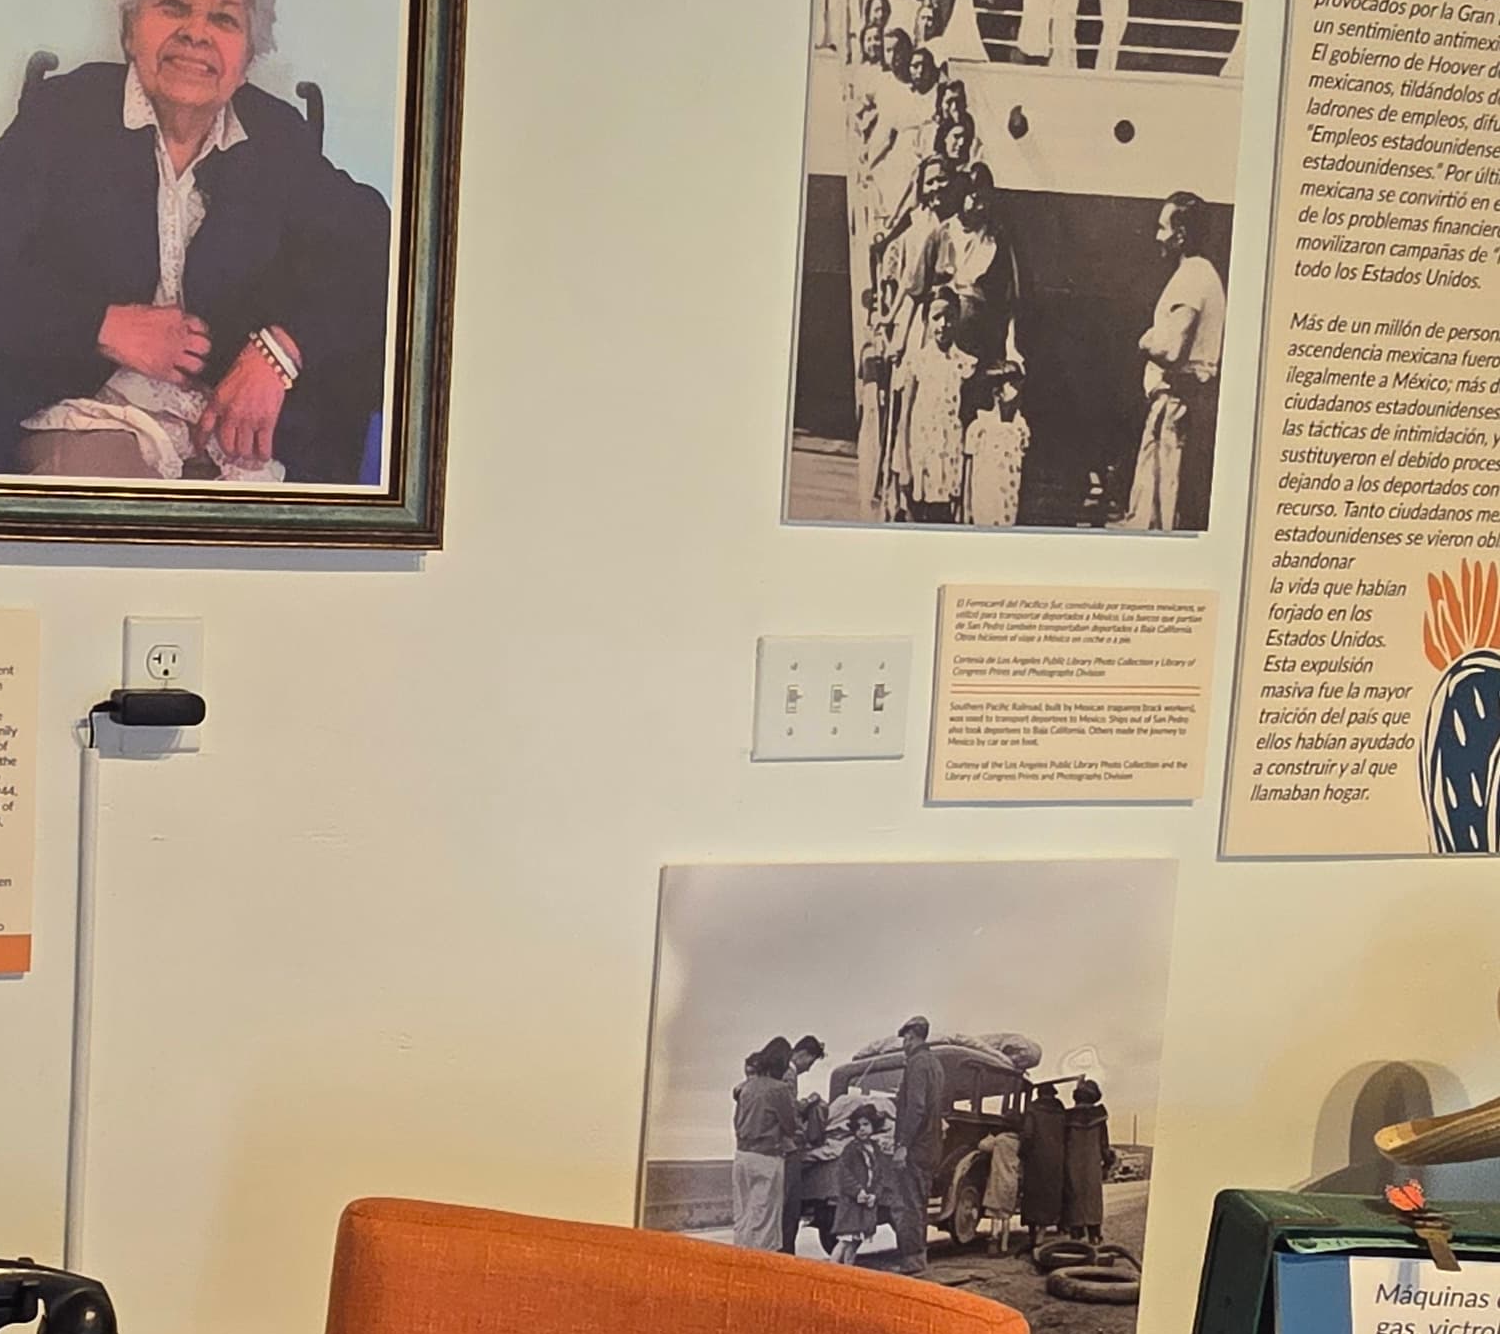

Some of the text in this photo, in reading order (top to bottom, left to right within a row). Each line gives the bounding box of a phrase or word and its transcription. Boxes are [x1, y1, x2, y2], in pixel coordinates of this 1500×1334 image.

[1311, 42, 1485, 77] El gobierno de Hoover
[1294, 259, 1481, 289] todo los Estados Unidos.
[1271, 550, 1357, 570] abandonar
[1269, 576, 1407, 599] la vida que habían
[1268, 602, 1373, 624] forjado en los
[1265, 628, 1386, 648] Estados Unidos.
[1263, 654, 1374, 676] Esta expulsión
[1260, 681, 1413, 703] masiva fue la mayor
[1258, 706, 1411, 728] traición del país que
[1256, 731, 1415, 754] ellos habían ayudado
[1252, 758, 1398, 780] a construir y al que
[1250, 783, 1370, 805] llamaban hogar.
[1375, 1282, 1490, 1310] Máquinas
